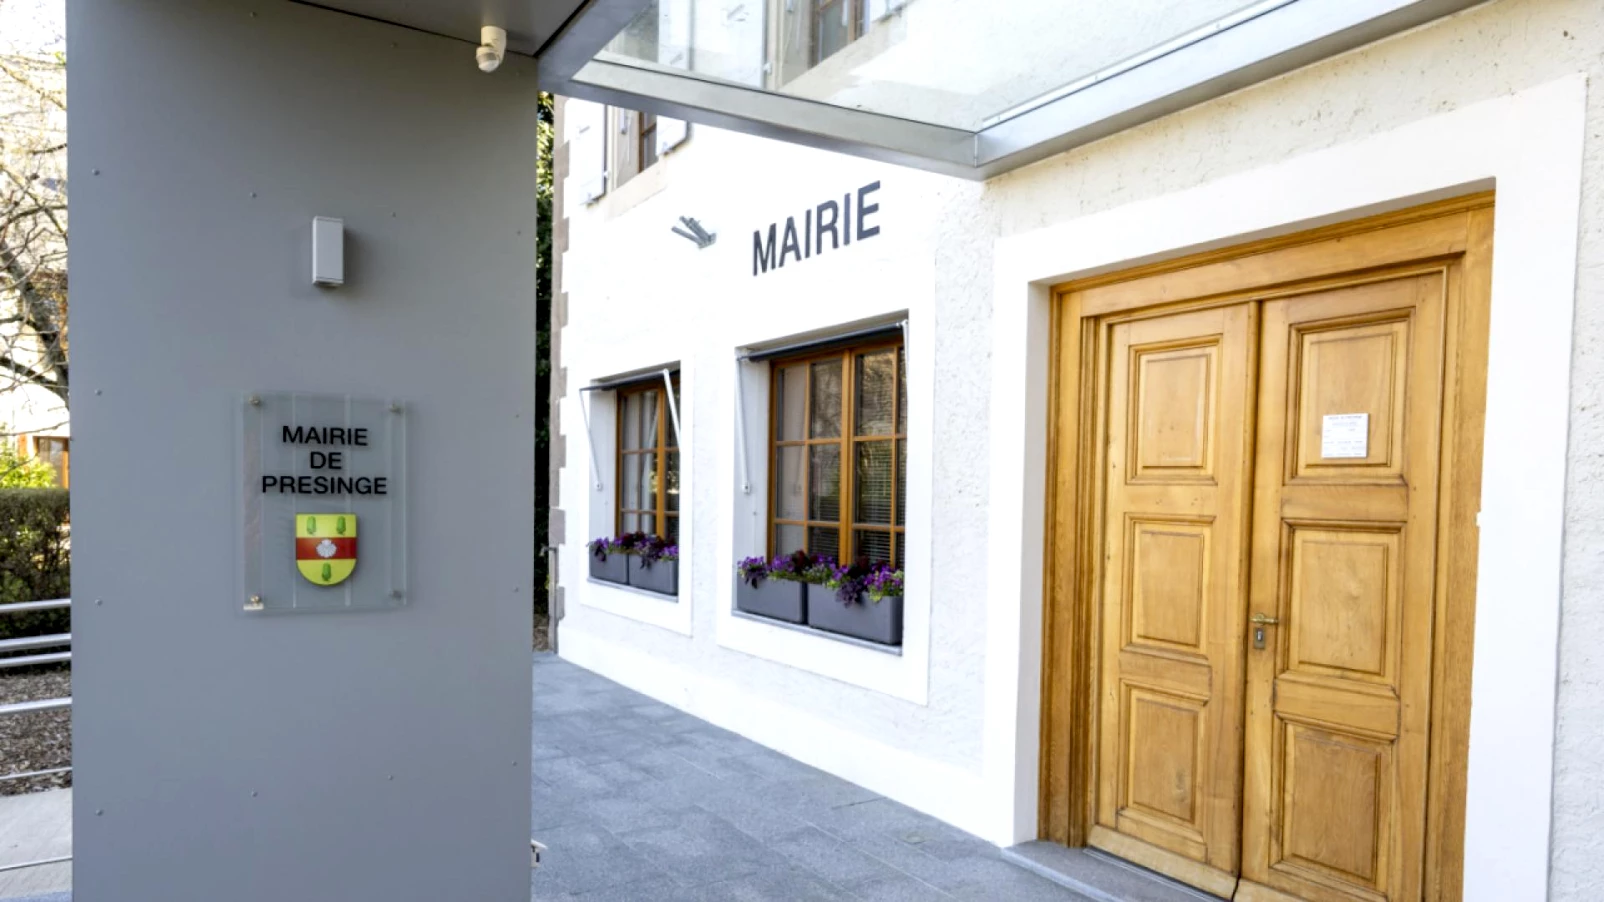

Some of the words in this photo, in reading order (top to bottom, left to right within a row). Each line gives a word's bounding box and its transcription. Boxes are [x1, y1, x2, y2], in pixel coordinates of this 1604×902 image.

[753, 180, 881, 276] MAIRIE
[282, 426, 368, 446] MAIRIE
[310, 451, 342, 469] DE
[262, 475, 387, 494] PRESINGE
